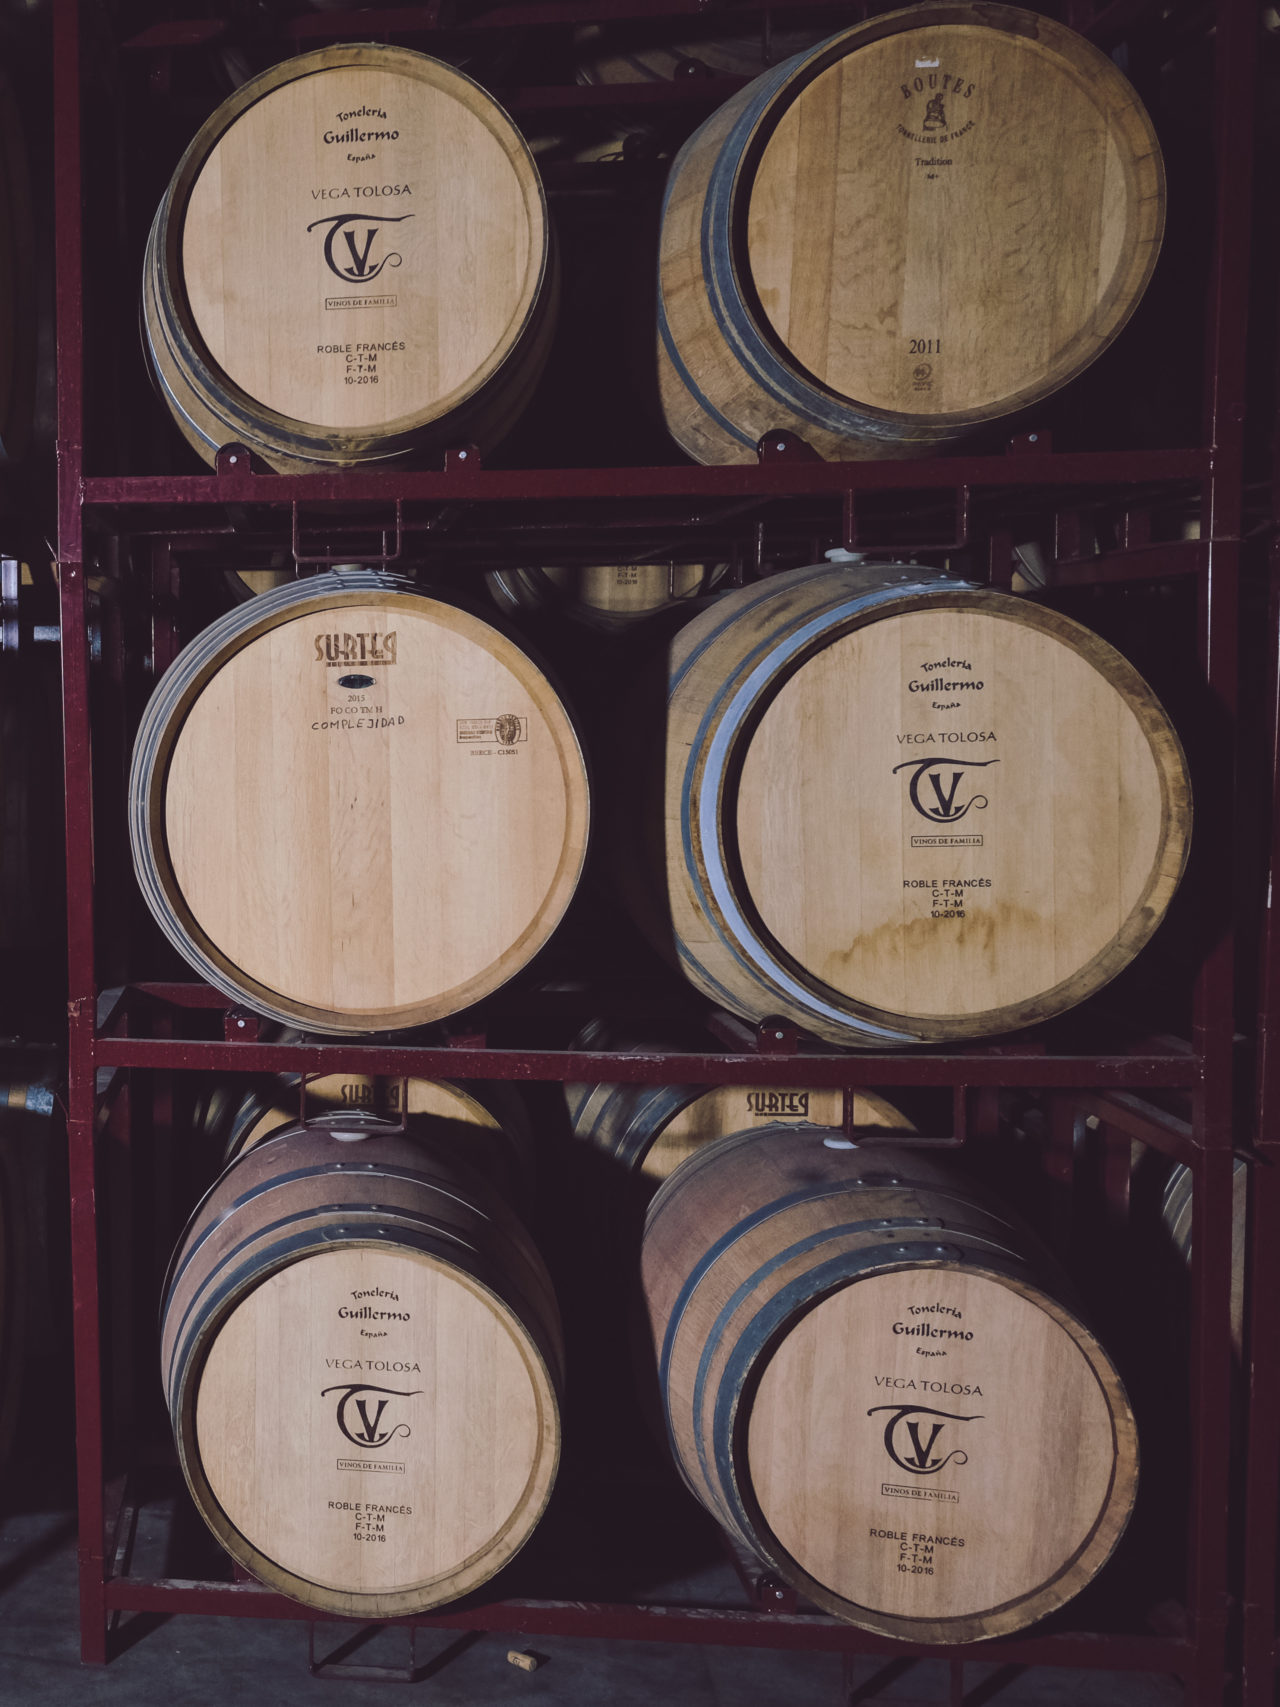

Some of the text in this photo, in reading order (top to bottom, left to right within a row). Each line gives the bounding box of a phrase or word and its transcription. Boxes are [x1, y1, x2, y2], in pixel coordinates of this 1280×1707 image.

[900, 73, 976, 99] BOUTES
[323, 128, 399, 144] Guillermo
[939, 134, 948, 143] DE
[950, 120, 976, 140] FRANCE
[347, 153, 376, 163] España
[915, 156, 952, 166] Tradition
[311, 184, 412, 200] VEGA TOLOSA
[364, 298, 395, 306] FAMILIA
[317, 341, 406, 353] ROBLE FRANCÉS
[909, 338, 941, 354] 2011
[345, 353, 377, 363] C-T-M
[346, 364, 377, 373] F-T-M
[344, 376, 379, 385] 10-2016
[908, 678, 984, 692] Guillermo
[932, 701, 961, 711] España
[311, 715, 405, 730] COMPLEJIDAD
[896, 731, 997, 744] VEGA TOLOSA
[903, 878, 992, 888] ROBLE FRANCÉS
[932, 889, 964, 898] C-T-M
[933, 899, 963, 908] F-T-M
[930, 910, 966, 919] 10-2016
[338, 1306, 410, 1321] Guillermo
[360, 1328, 388, 1339] España
[892, 1322, 974, 1341] Guillermo
[915, 1346, 947, 1358] España
[325, 1358, 421, 1373] VEGA TOLOSA
[874, 1375, 983, 1397] VEGA TOLOSA
[339, 1461, 362, 1469] VINOS
[373, 1463, 403, 1472] FAMILIA
[884, 1486, 956, 1501] VINOS DE FAMILIA
[328, 1501, 412, 1515] ROBLE FRANCÉS
[355, 1512, 385, 1522] C-T-M
[355, 1523, 384, 1532] F-T-M
[353, 1533, 386, 1543] 10-2016
[869, 1528, 965, 1547] ROBLE FRANCÉS
[900, 1542, 934, 1554] C-T-M
[900, 1553, 933, 1564] F-T-M
[897, 1564, 934, 1575] 10-2016
